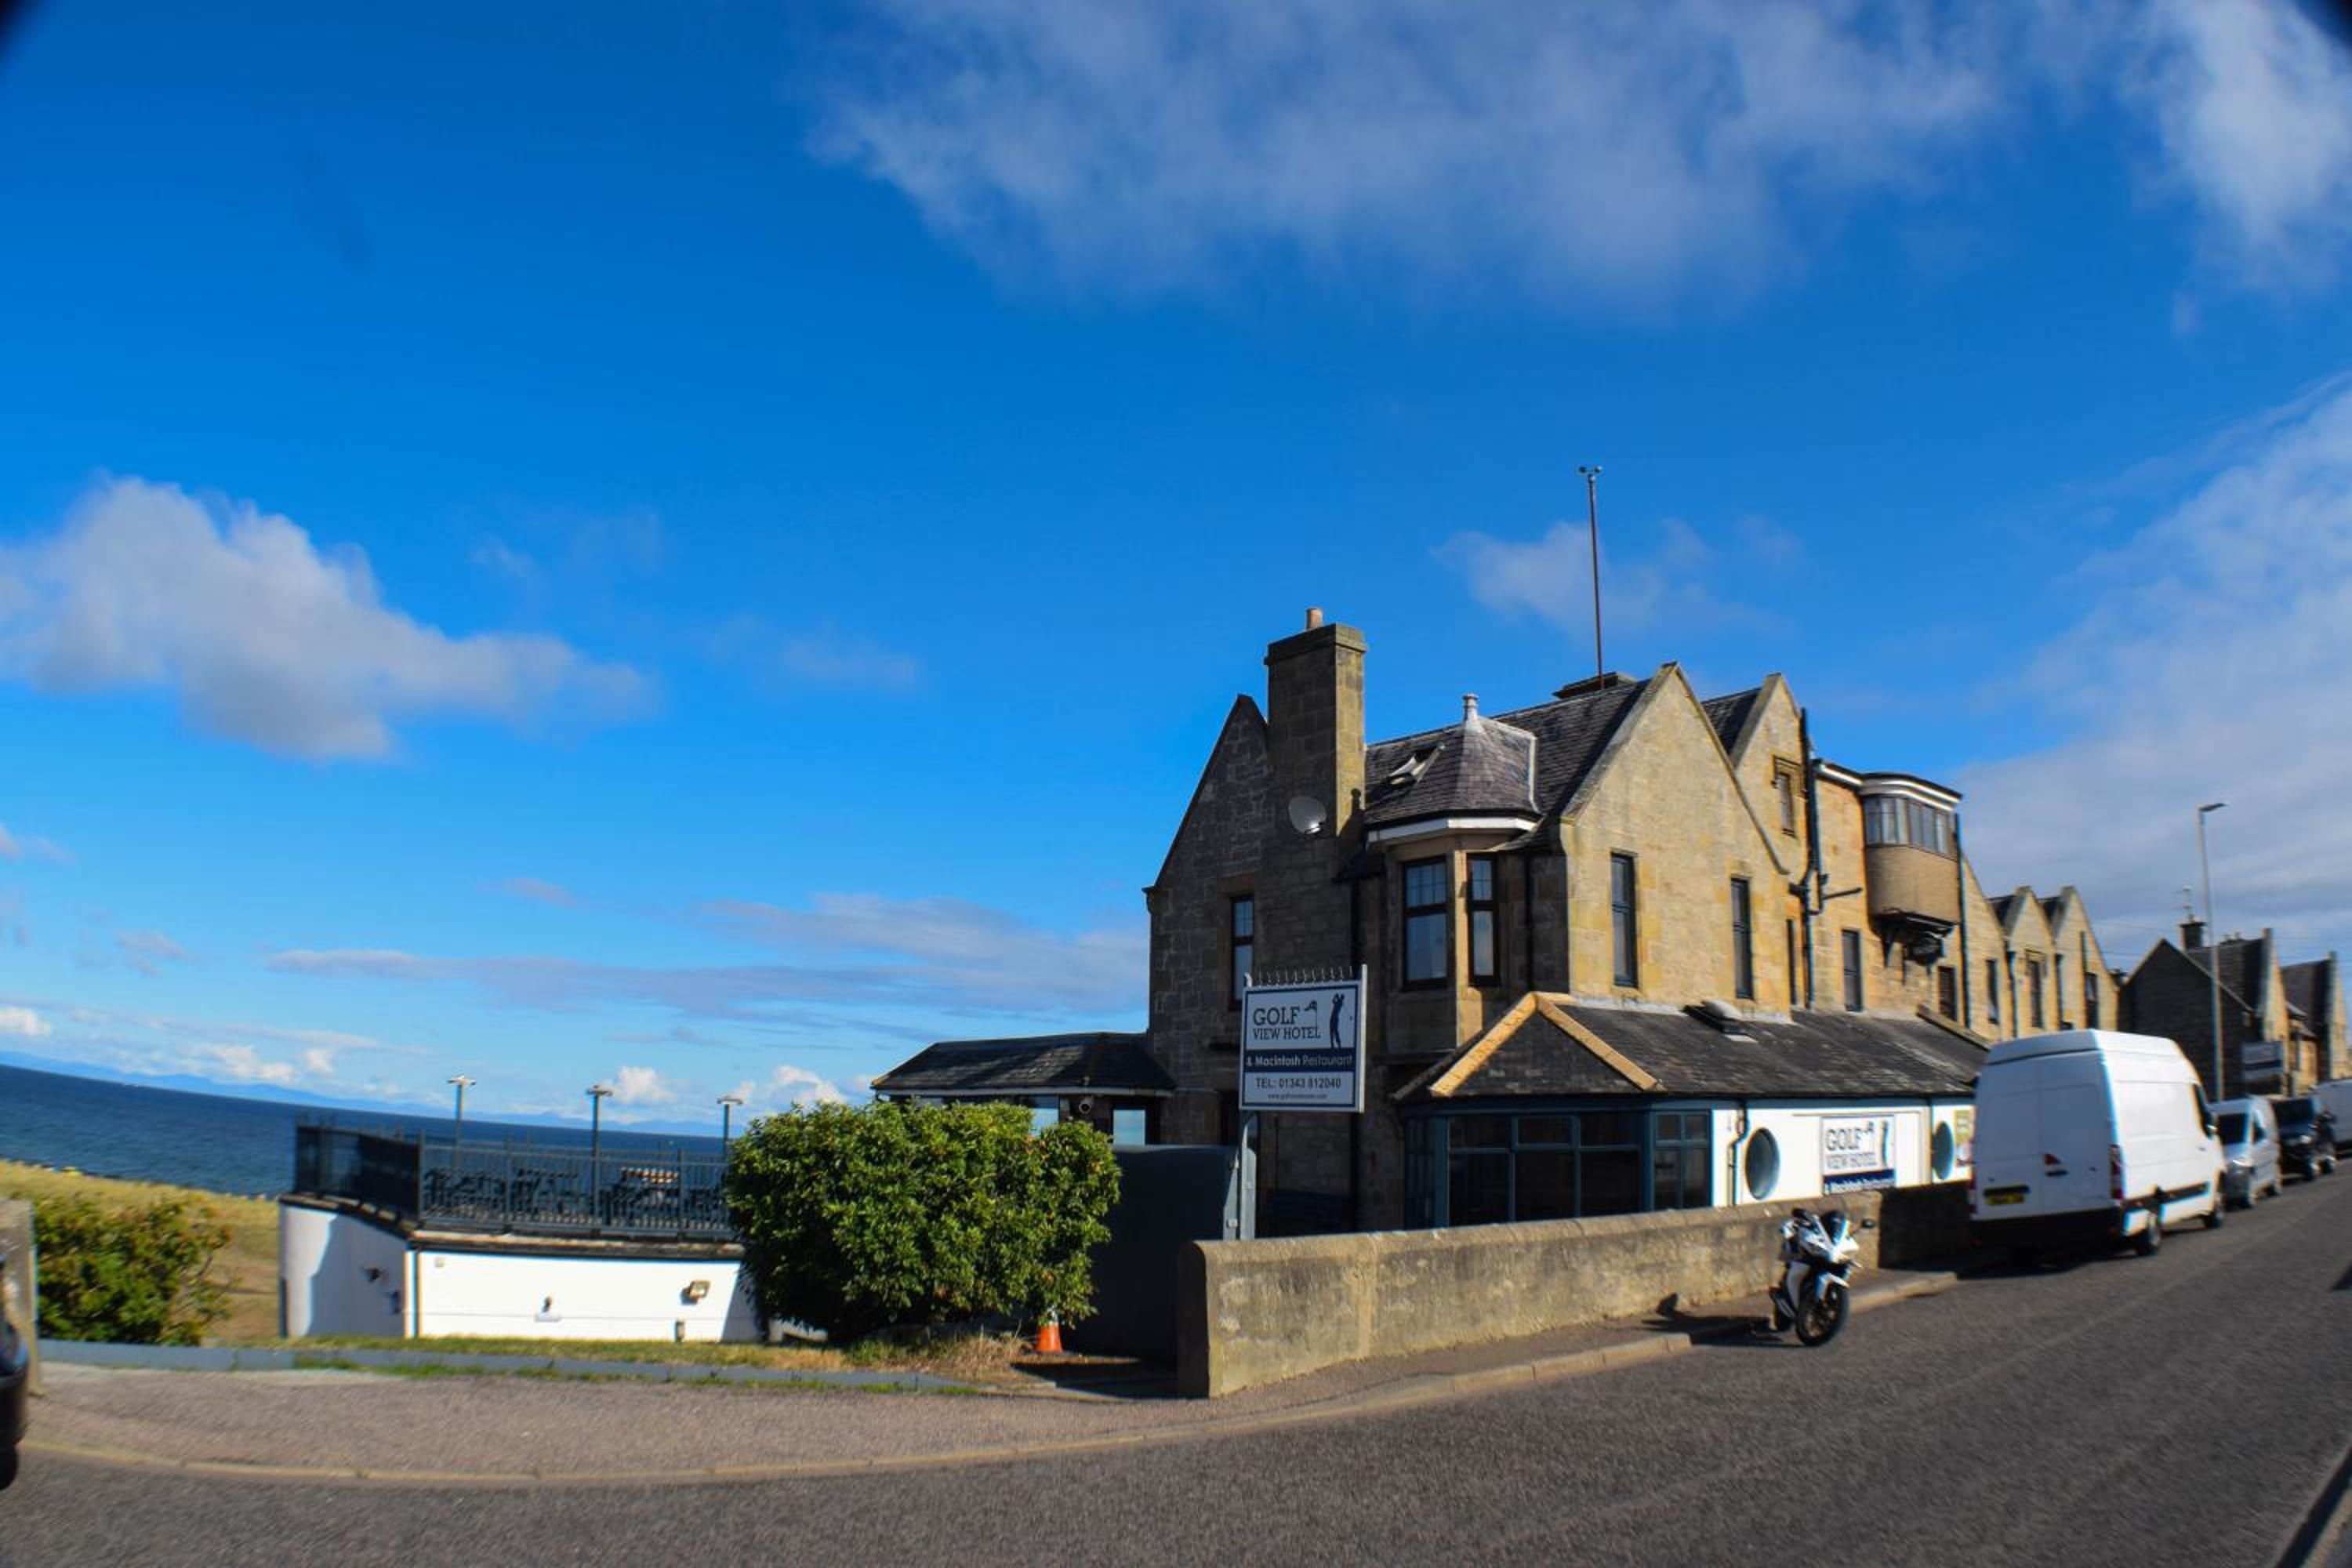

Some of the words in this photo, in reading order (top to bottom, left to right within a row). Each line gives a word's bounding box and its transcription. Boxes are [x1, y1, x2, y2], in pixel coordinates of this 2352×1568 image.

[1253, 1007, 1301, 1026] GOLF
[1253, 1028, 1280, 1041] VIEW
[1283, 1026, 1321, 1040] HOTEL
[1302, 1054, 1353, 1067] Restaurant
[1255, 1077, 1276, 1089] TEL:
[1279, 1077, 1305, 1089] 01343
